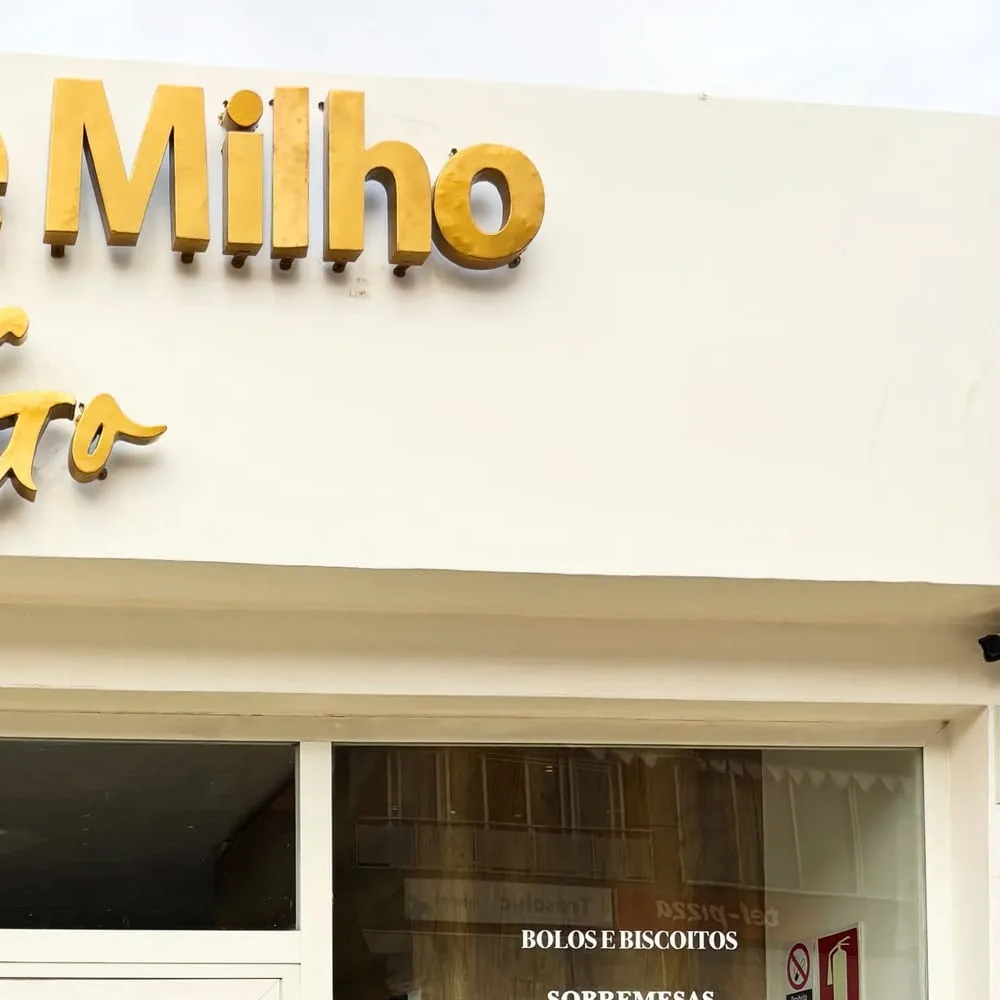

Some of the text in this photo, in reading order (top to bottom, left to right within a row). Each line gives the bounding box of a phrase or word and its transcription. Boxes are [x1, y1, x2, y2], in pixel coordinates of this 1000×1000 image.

[42, 79, 546, 270] Milho
[522, 930, 738, 950] BOLOS E BISCOITOS
